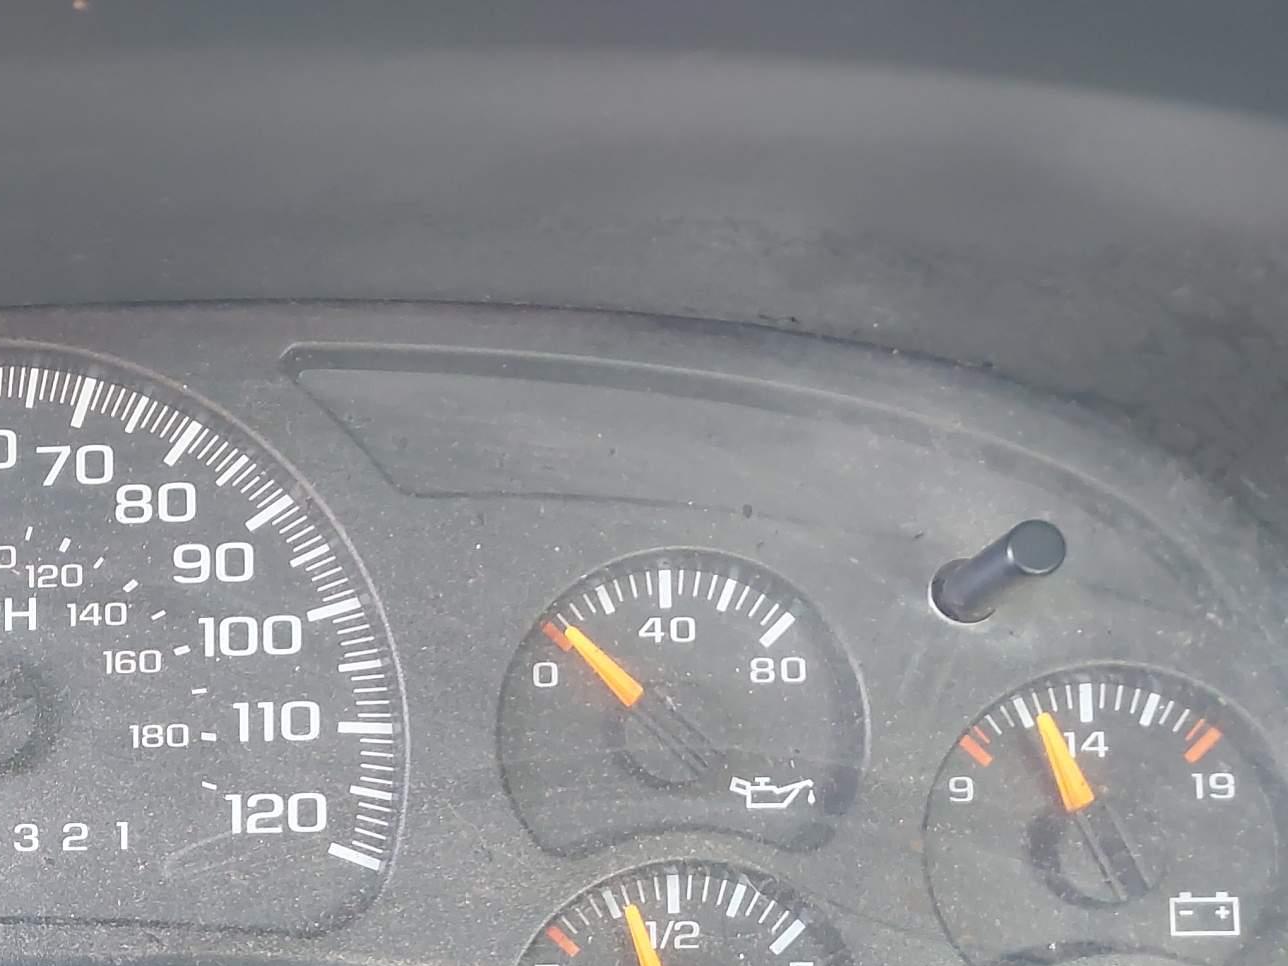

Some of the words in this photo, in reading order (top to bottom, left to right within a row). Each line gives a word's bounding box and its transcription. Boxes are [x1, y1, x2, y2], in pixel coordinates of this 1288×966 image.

[36, 445, 113, 486] 70
[116, 483, 196, 524] 80
[26, 564, 83, 588] 120
[173, 542, 254, 583] 90
[67, 603, 127, 625] 140
[199, 615, 302, 656] 100
[639, 617, 696, 643] 40
[103, 651, 161, 674] 160
[750, 657, 806, 682] 80
[233, 701, 319, 742] 110
[130, 724, 189, 747] 180
[1063, 731, 1108, 757] 14
[949, 777, 974, 802] 9
[1192, 772, 1236, 799] 19
[225, 793, 327, 833] 120
[14, 824, 39, 852] 3
[63, 823, 88, 851] 2
[117, 822, 128, 850] 1
[650, 921, 700, 949] 1/2
